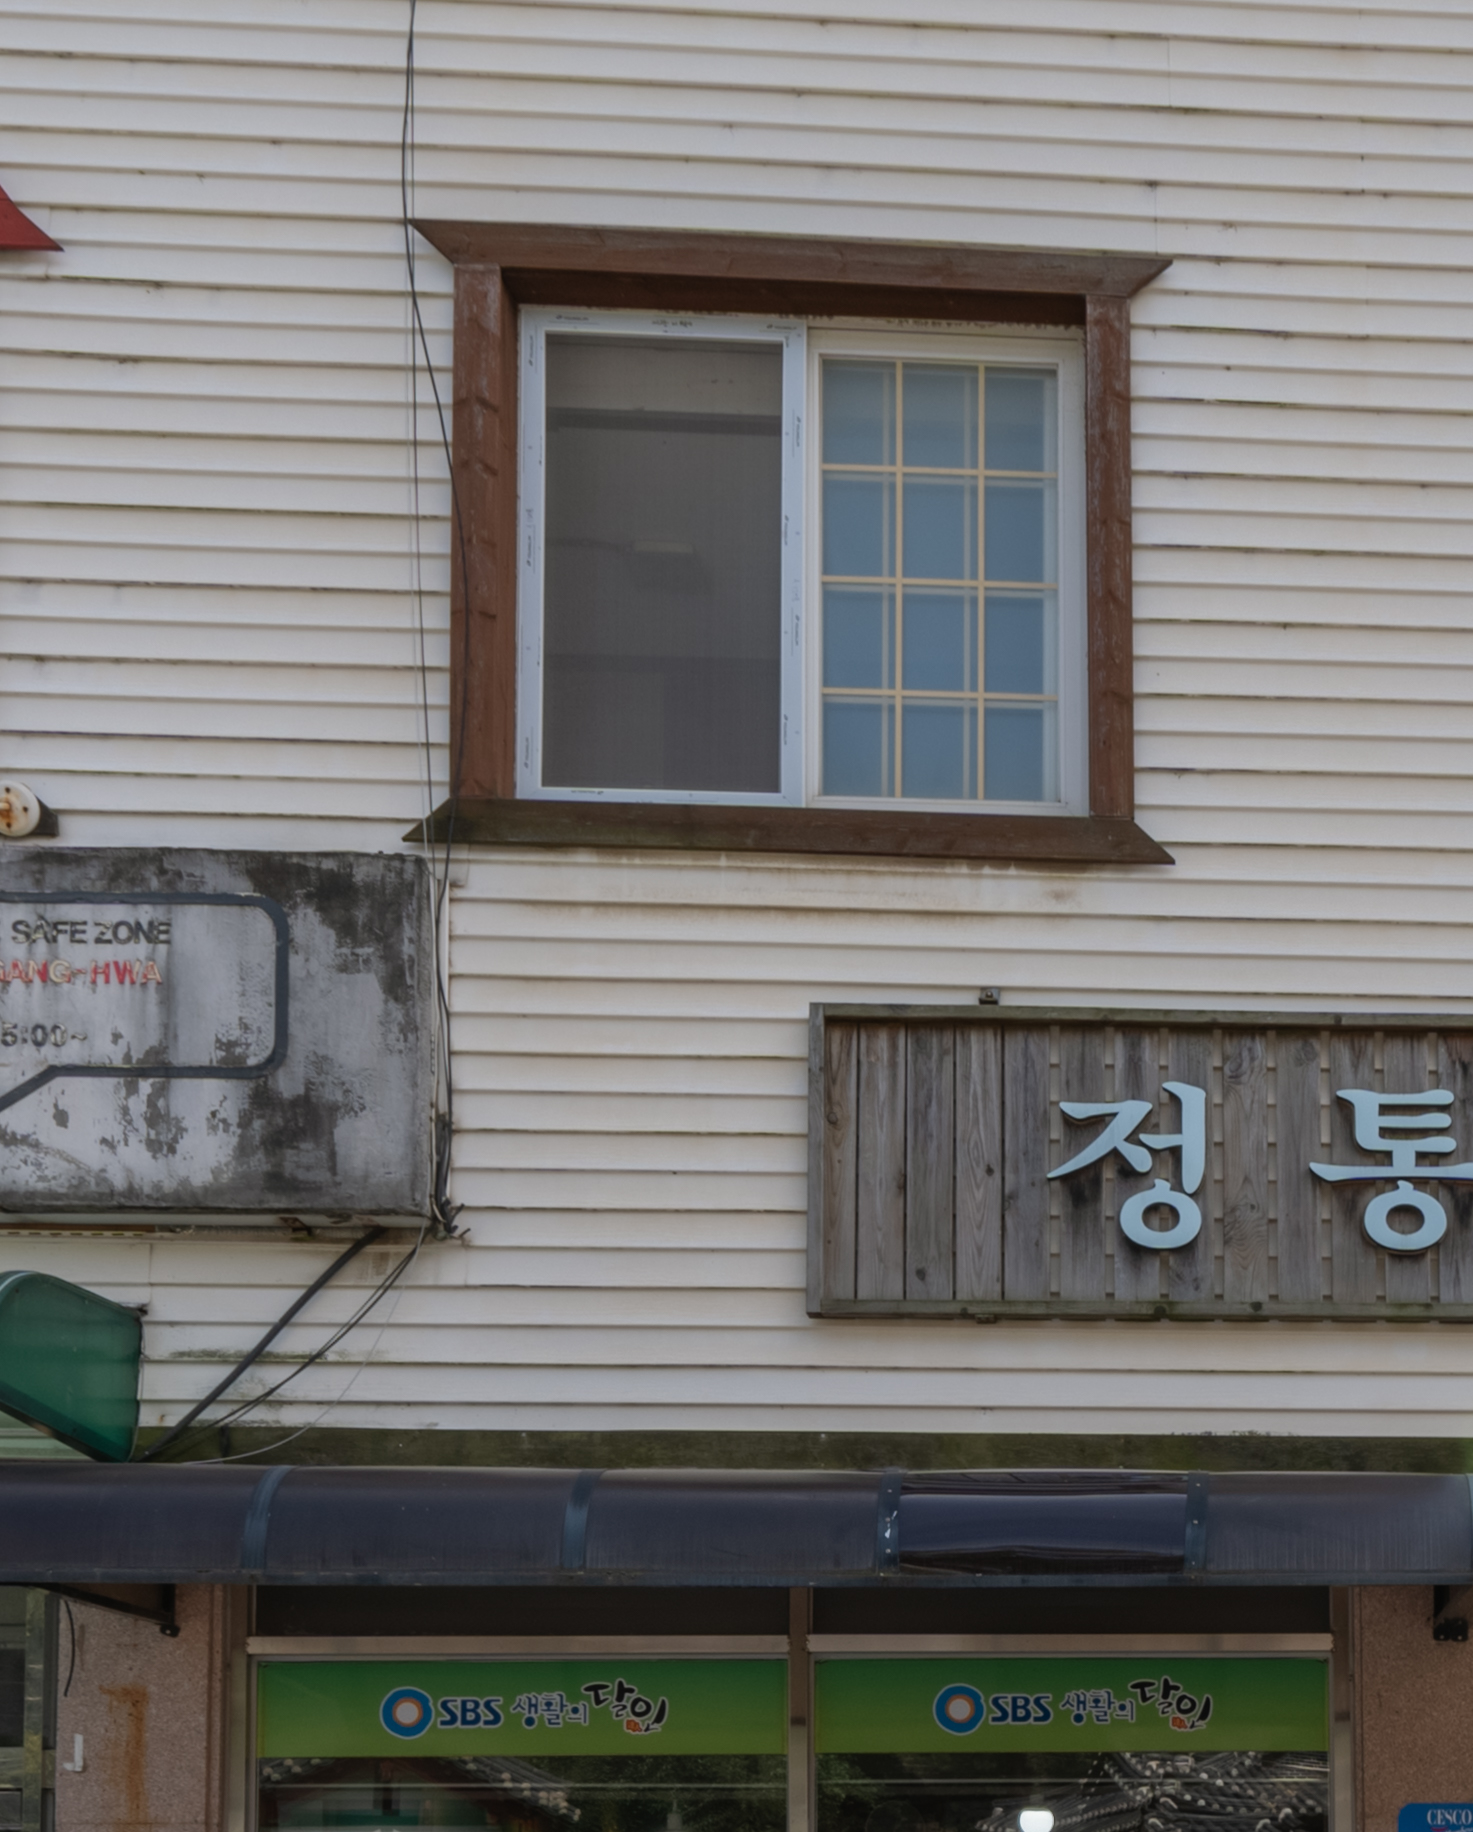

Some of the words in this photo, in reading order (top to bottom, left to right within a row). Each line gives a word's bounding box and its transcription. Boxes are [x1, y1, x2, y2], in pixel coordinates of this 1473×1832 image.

[10, 915, 88, 945] SAFE
[93, 920, 172, 946] ZONE
[439, 1698, 502, 1728] SBS
[511, 1692, 589, 1728] 생활의
[989, 1695, 1052, 1723] SBS
[1060, 1689, 1135, 1725] 생활의
[1426, 1808, 1473, 1826] CESCO
